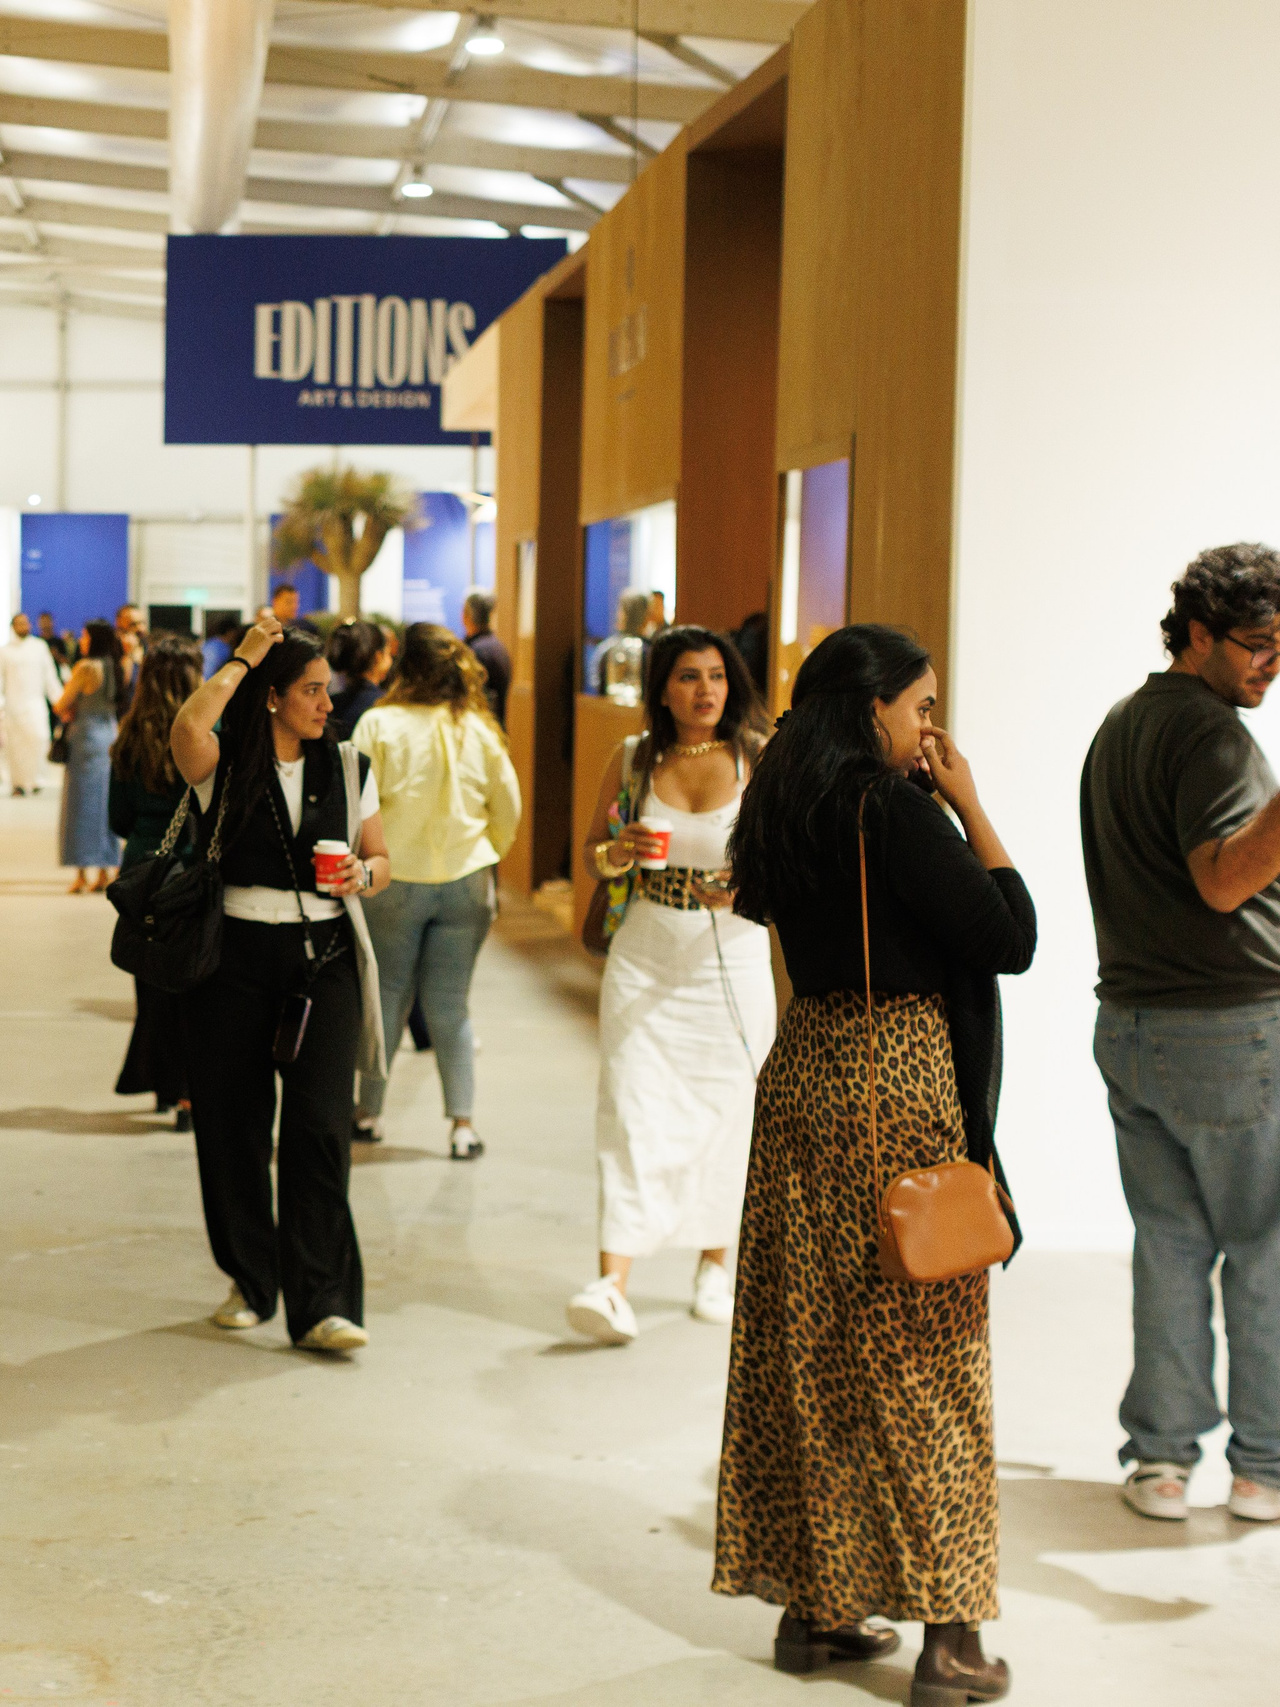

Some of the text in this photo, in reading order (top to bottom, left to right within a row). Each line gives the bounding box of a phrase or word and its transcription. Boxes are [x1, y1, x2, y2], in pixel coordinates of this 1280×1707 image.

[254, 293, 477, 389] EDITIONS
[297, 389, 431, 409] ART & DESIGN
